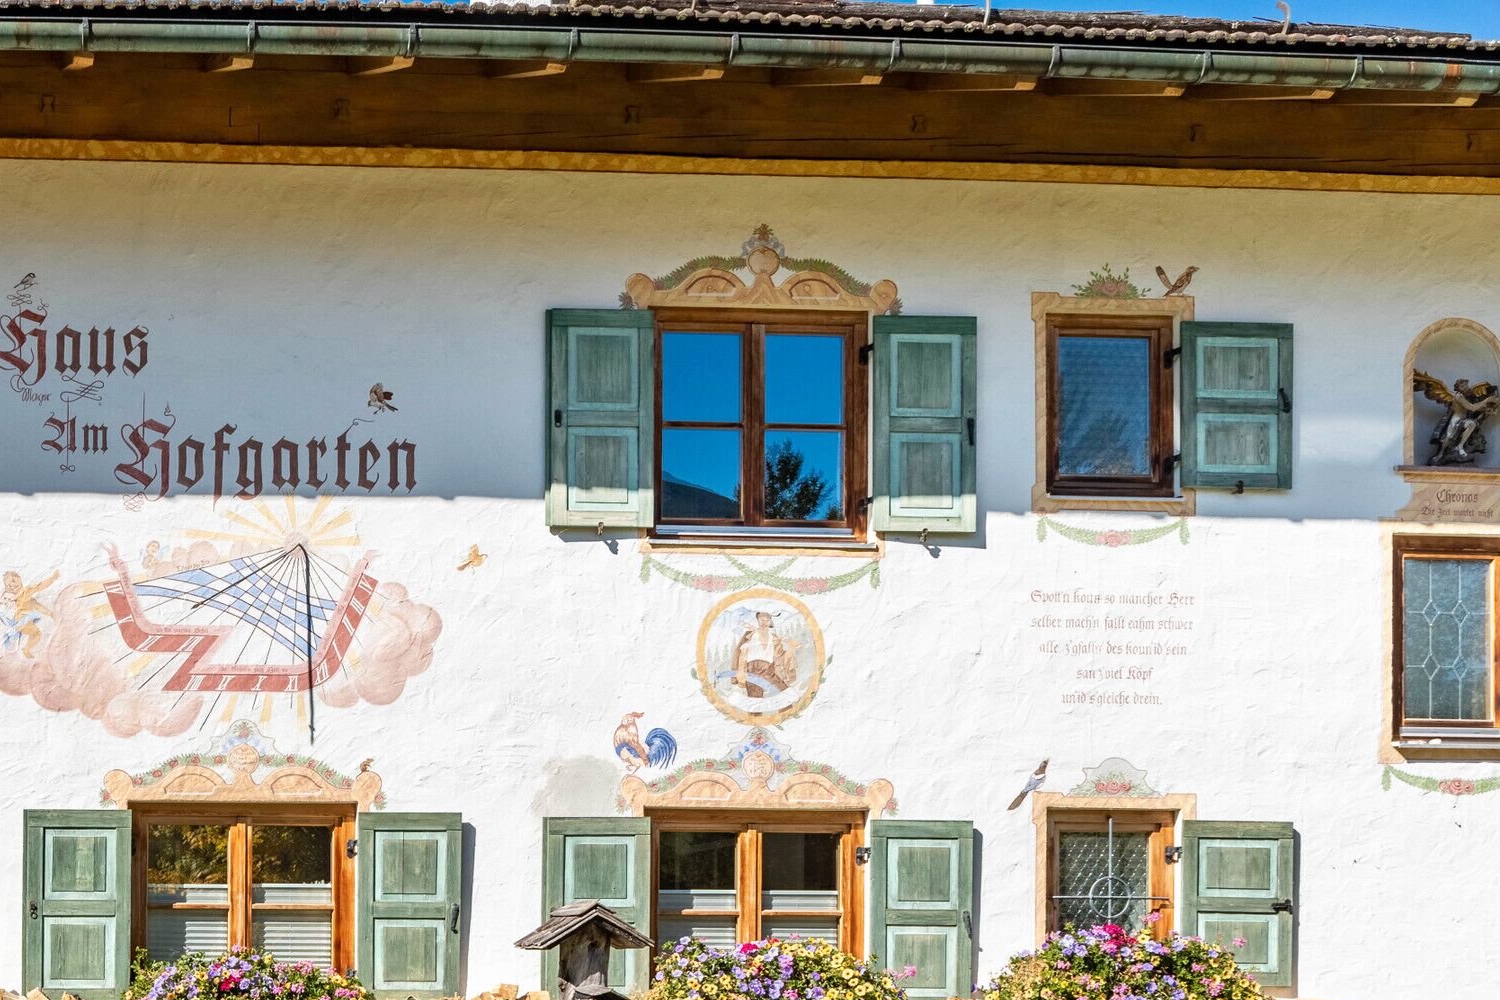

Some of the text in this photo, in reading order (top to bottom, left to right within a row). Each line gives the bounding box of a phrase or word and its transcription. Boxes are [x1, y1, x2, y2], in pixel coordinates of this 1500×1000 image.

[41, 413, 418, 507] Am Hofgarten
[1436, 489, 1479, 504] Chronos
[1421, 507, 1435, 516] Die
[1104, 594, 1115, 604] so
[1119, 591, 1163, 607] mancher
[1167, 592, 1195, 608] Herr
[1031, 614, 1062, 629] selber
[1158, 615, 1193, 632] schwer
[1040, 640, 1059, 653] alle
[1106, 640, 1123, 655] des
[1166, 642, 1188, 655] sein
[1076, 668, 1095, 679] san
